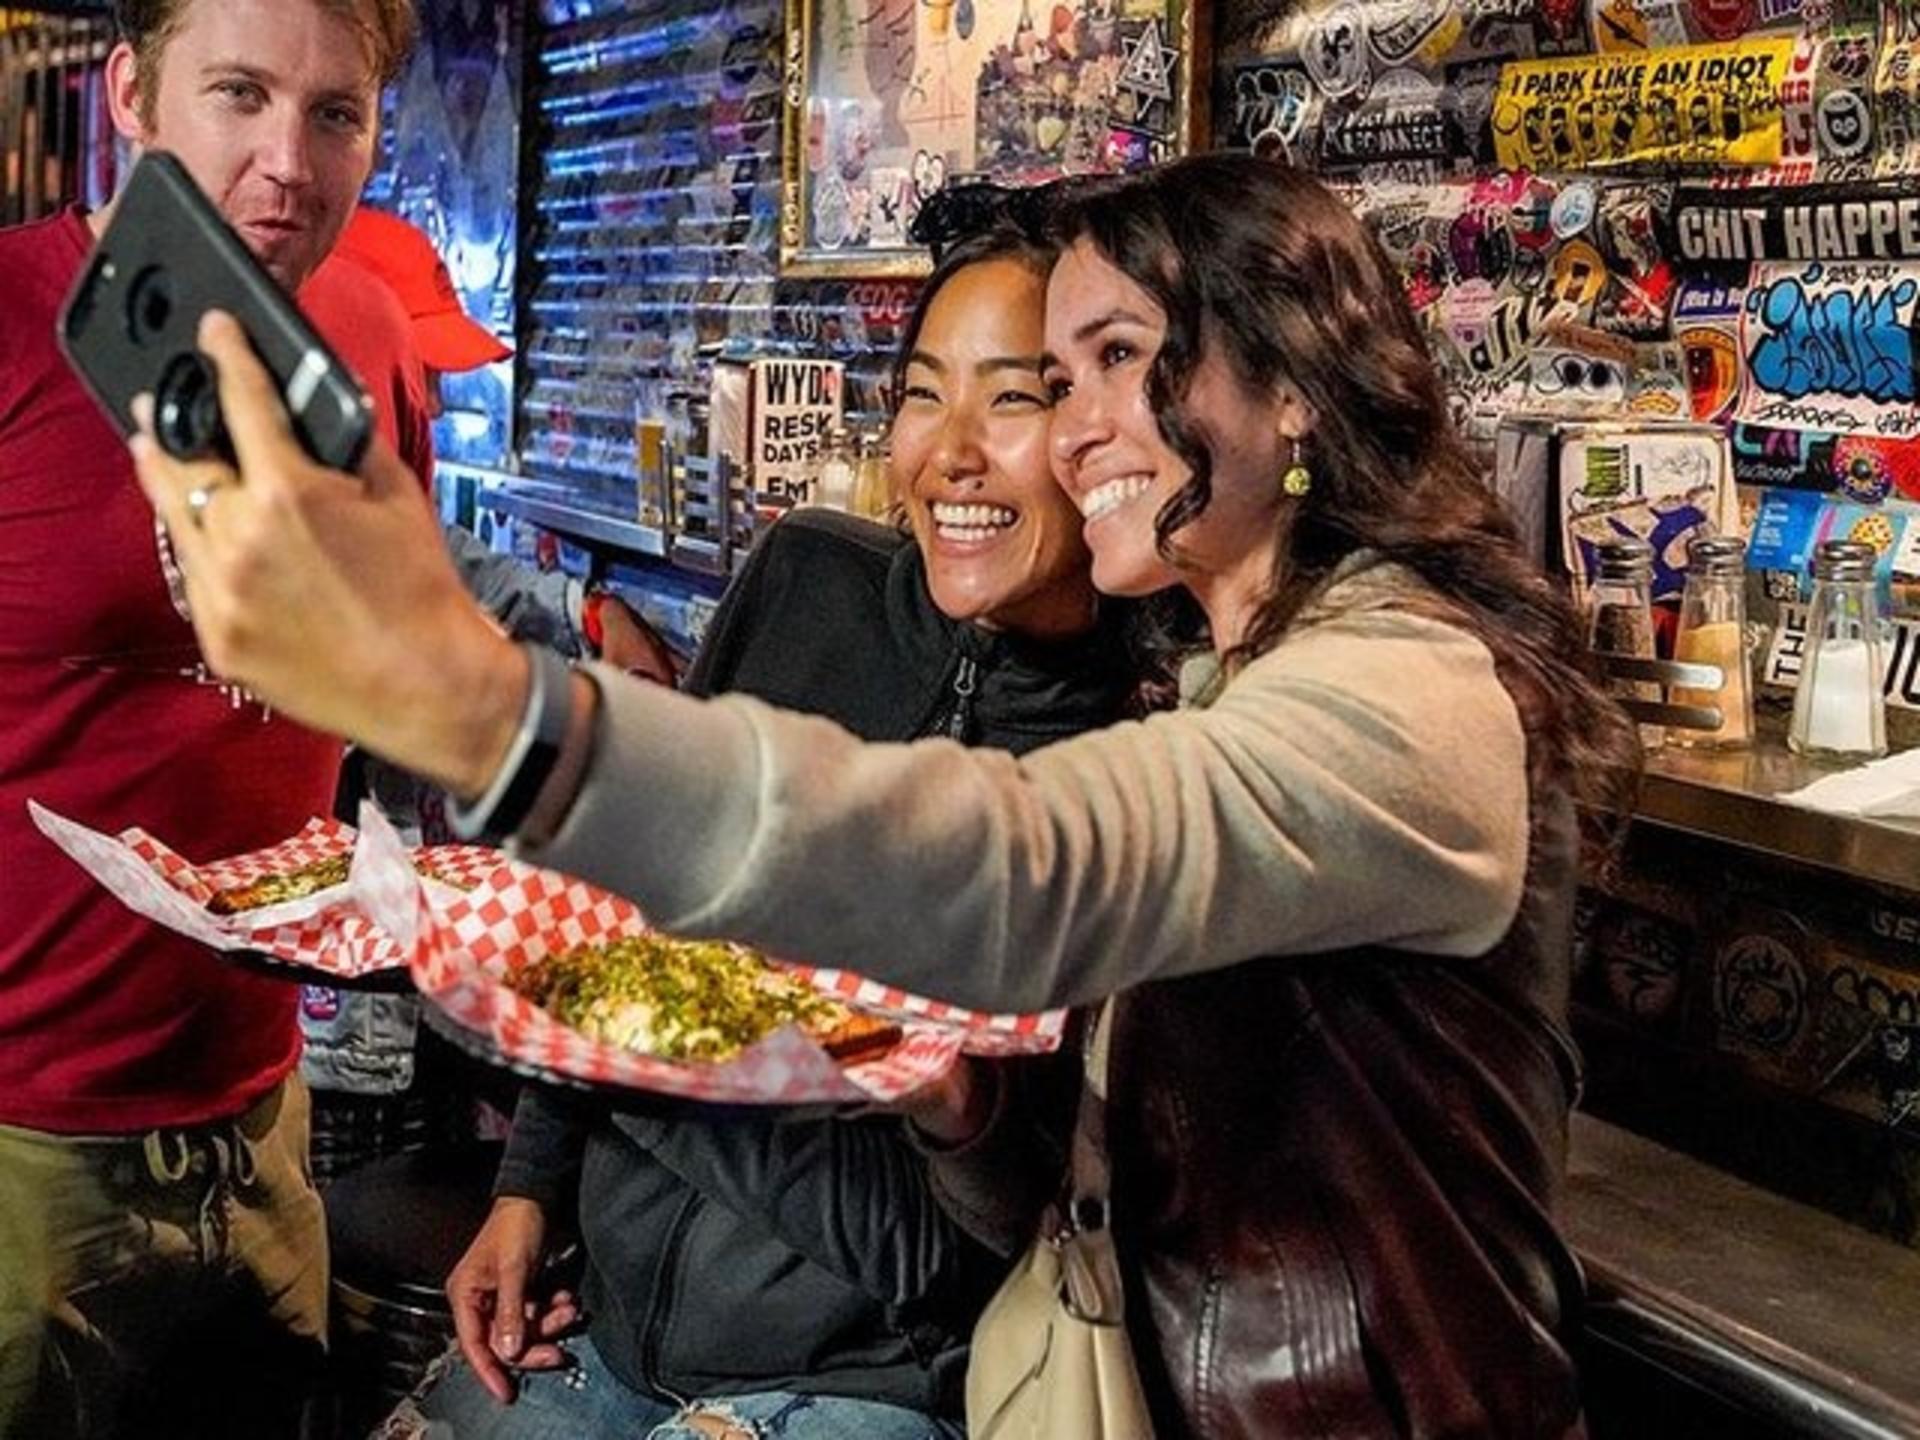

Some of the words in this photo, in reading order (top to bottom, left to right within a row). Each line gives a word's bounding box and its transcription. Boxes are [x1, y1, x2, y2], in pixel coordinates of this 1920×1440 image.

[1510, 72, 1522, 96] I
[1522, 68, 1587, 96] PARK
[1591, 65, 1647, 91] LIKE
[1649, 61, 1692, 86] AN
[1696, 54, 1774, 81] IDIOT
[1678, 205, 1767, 259] CHIT
[1783, 199, 1920, 259] HAPPE
[764, 439, 818, 463] DAYS
[767, 475, 818, 502] EM
